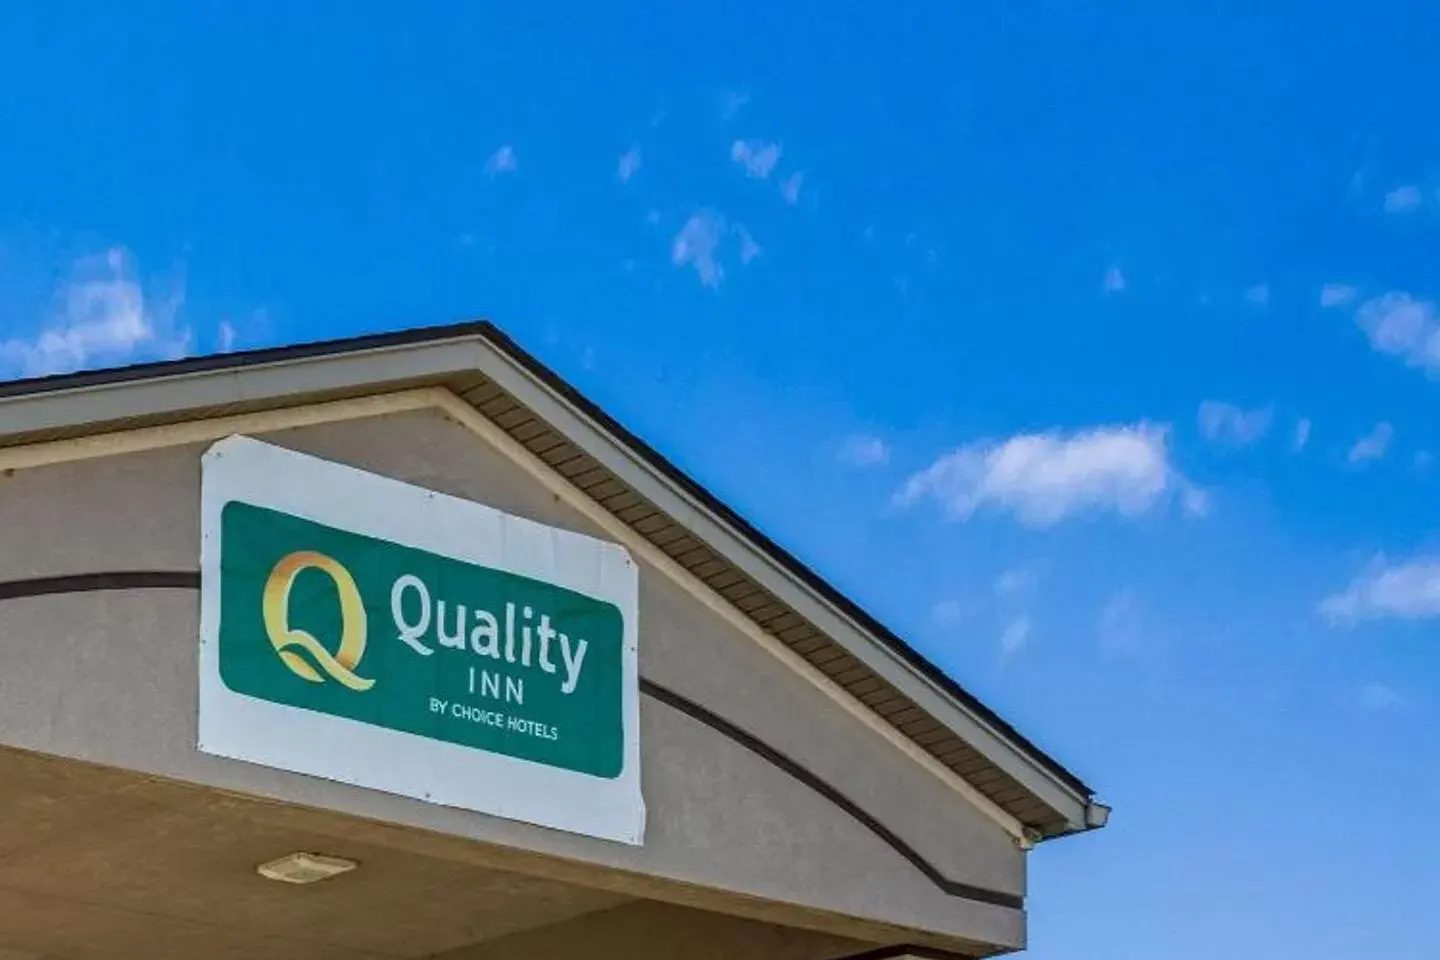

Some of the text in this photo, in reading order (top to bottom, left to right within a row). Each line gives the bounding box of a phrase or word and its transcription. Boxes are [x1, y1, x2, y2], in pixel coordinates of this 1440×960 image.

[262, 550, 376, 691] Q
[391, 574, 588, 694] Quality
[429, 697, 558, 740] BY CHOICE HOTELS
[469, 667, 524, 705] INN
